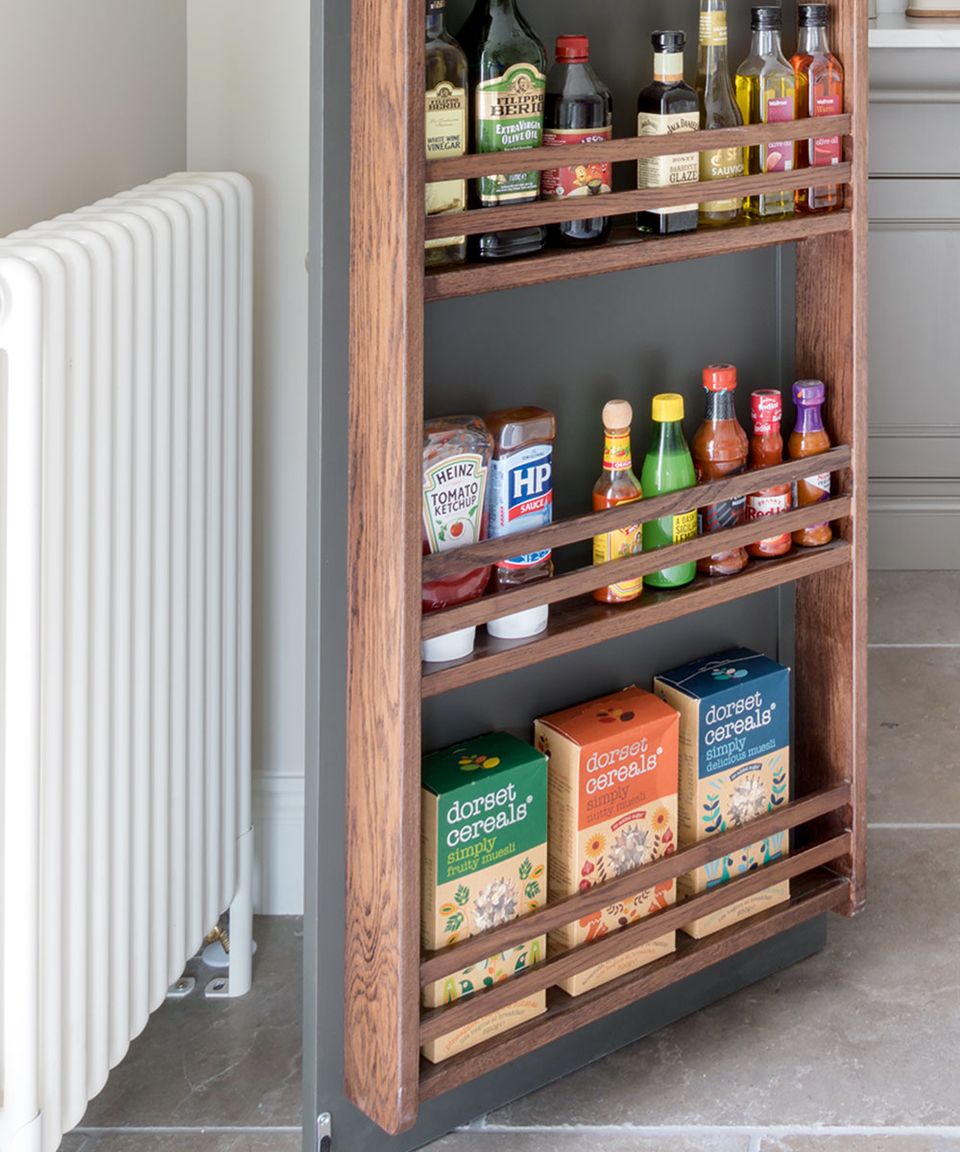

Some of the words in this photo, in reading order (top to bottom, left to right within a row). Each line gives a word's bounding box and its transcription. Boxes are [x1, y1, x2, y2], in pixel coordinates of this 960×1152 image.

[427, 141, 461, 152] VINEGAR
[446, 134, 460, 142] WINE
[669, 170, 698, 184] GLAZE
[436, 464, 474, 485] HEINZ
[513, 462, 551, 499] HP
[431, 482, 478, 506] TOMATO
[435, 495, 477, 516] KETCHUP
[520, 498, 545, 514] SAUCE
[705, 691, 762, 725] dorset
[704, 708, 772, 745] cereals
[586, 737, 648, 774] dorset
[706, 737, 746, 761] simply
[706, 751, 746, 772] delicious
[748, 738, 776, 757] muesli
[585, 754, 657, 795] cereals
[446, 782, 517, 824] dorset
[587, 785, 630, 812] simply
[446, 803, 528, 847] cereals
[587, 807, 613, 824] nutty
[447, 837, 497, 865] simply
[447, 858, 480, 878] fruity
[482, 842, 517, 865] muesli
